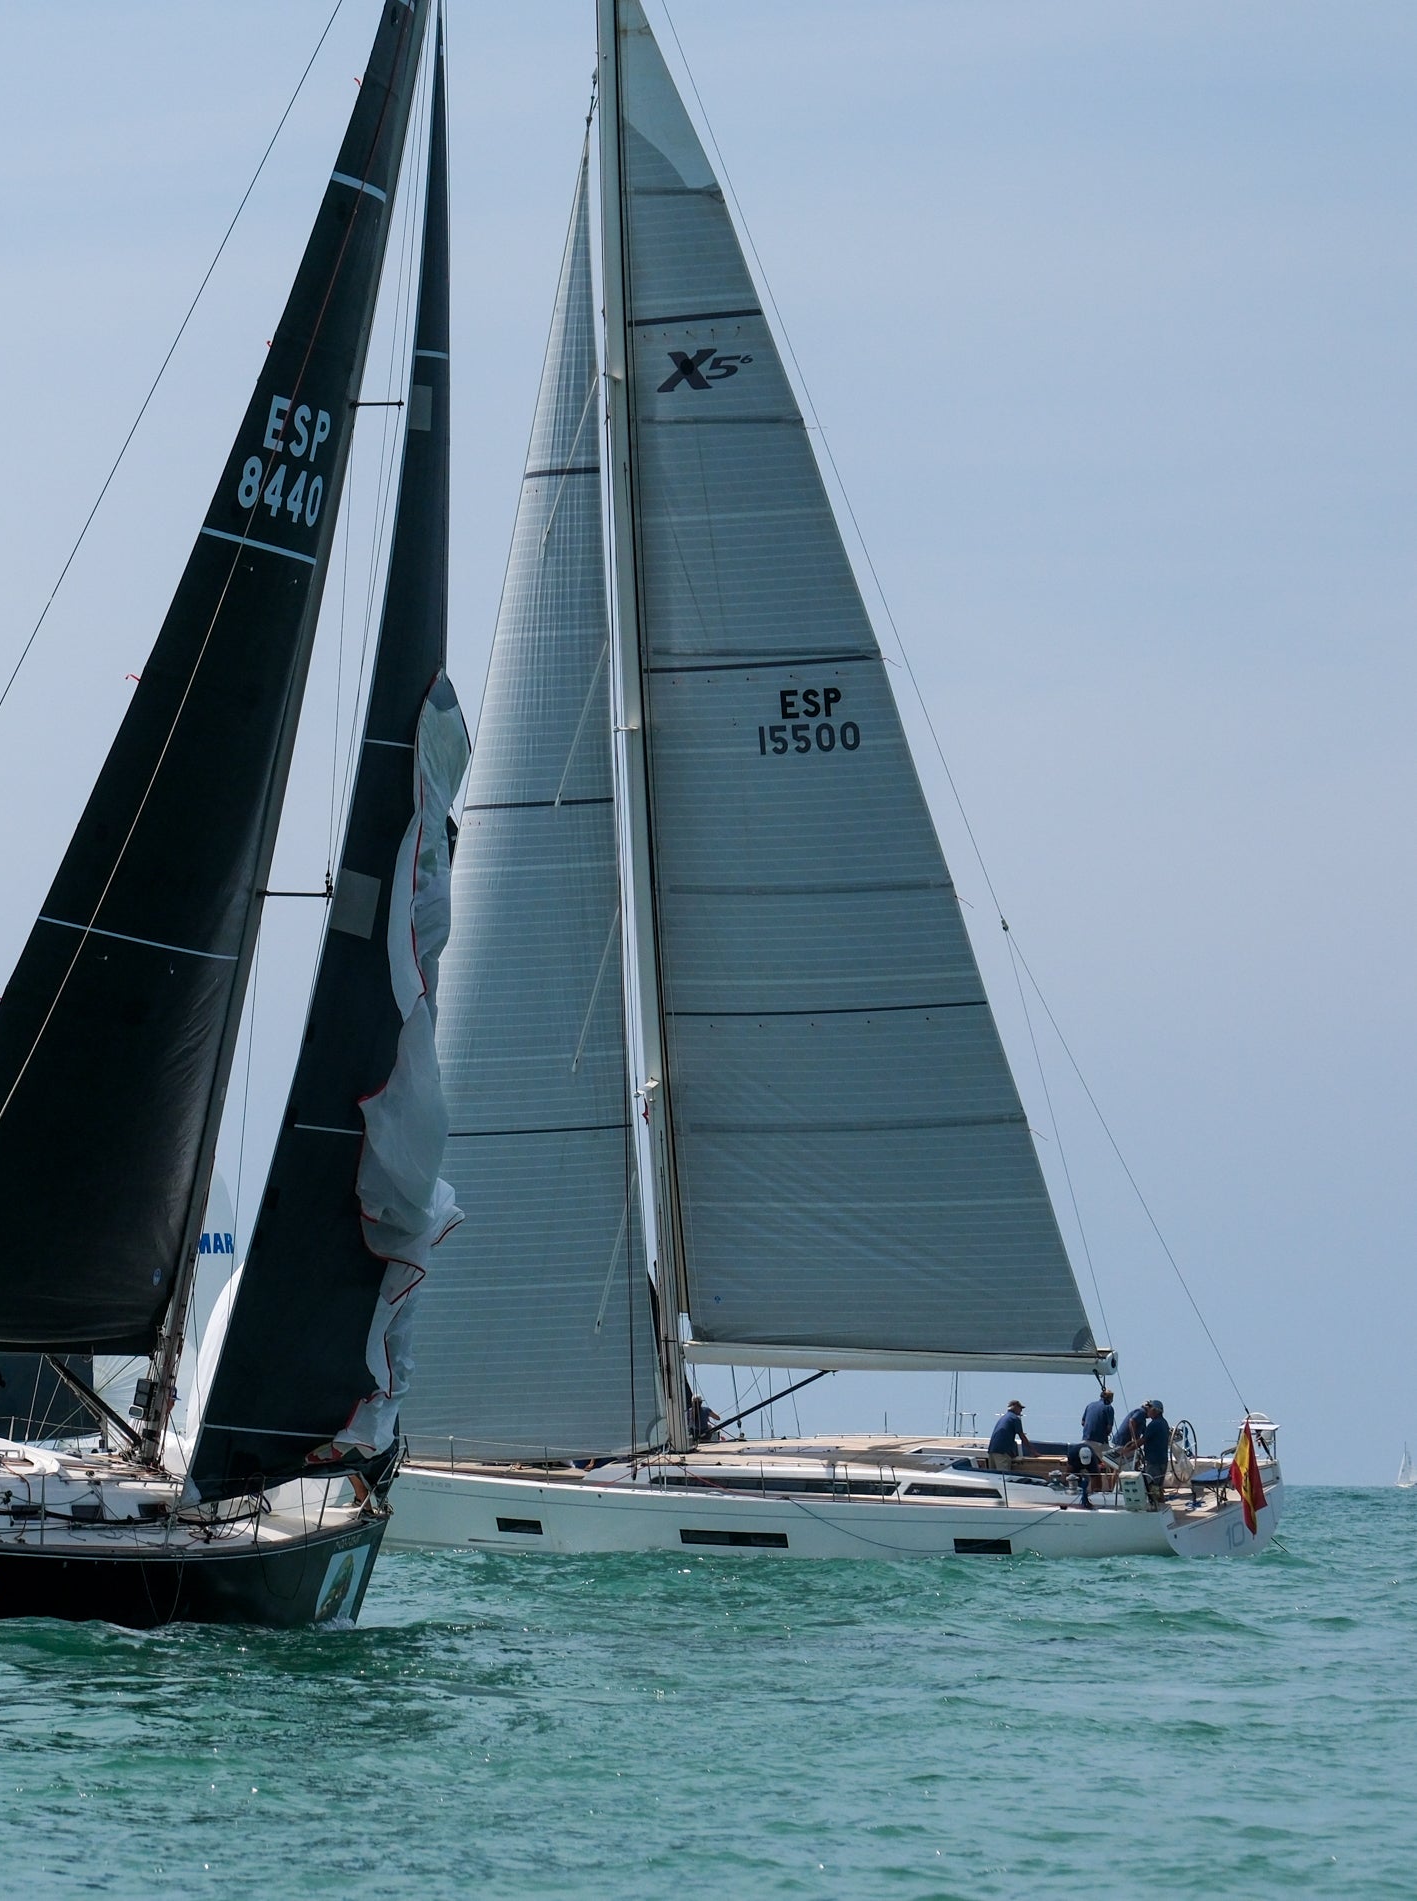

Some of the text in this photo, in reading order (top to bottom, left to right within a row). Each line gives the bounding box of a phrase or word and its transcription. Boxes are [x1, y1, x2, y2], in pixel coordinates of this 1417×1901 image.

[263, 394, 331, 463] ESP
[237, 455, 324, 528] 8440
[780, 687, 842, 720] ESP
[758, 721, 861, 756] 15500
[1225, 1521, 1245, 1550] 10
